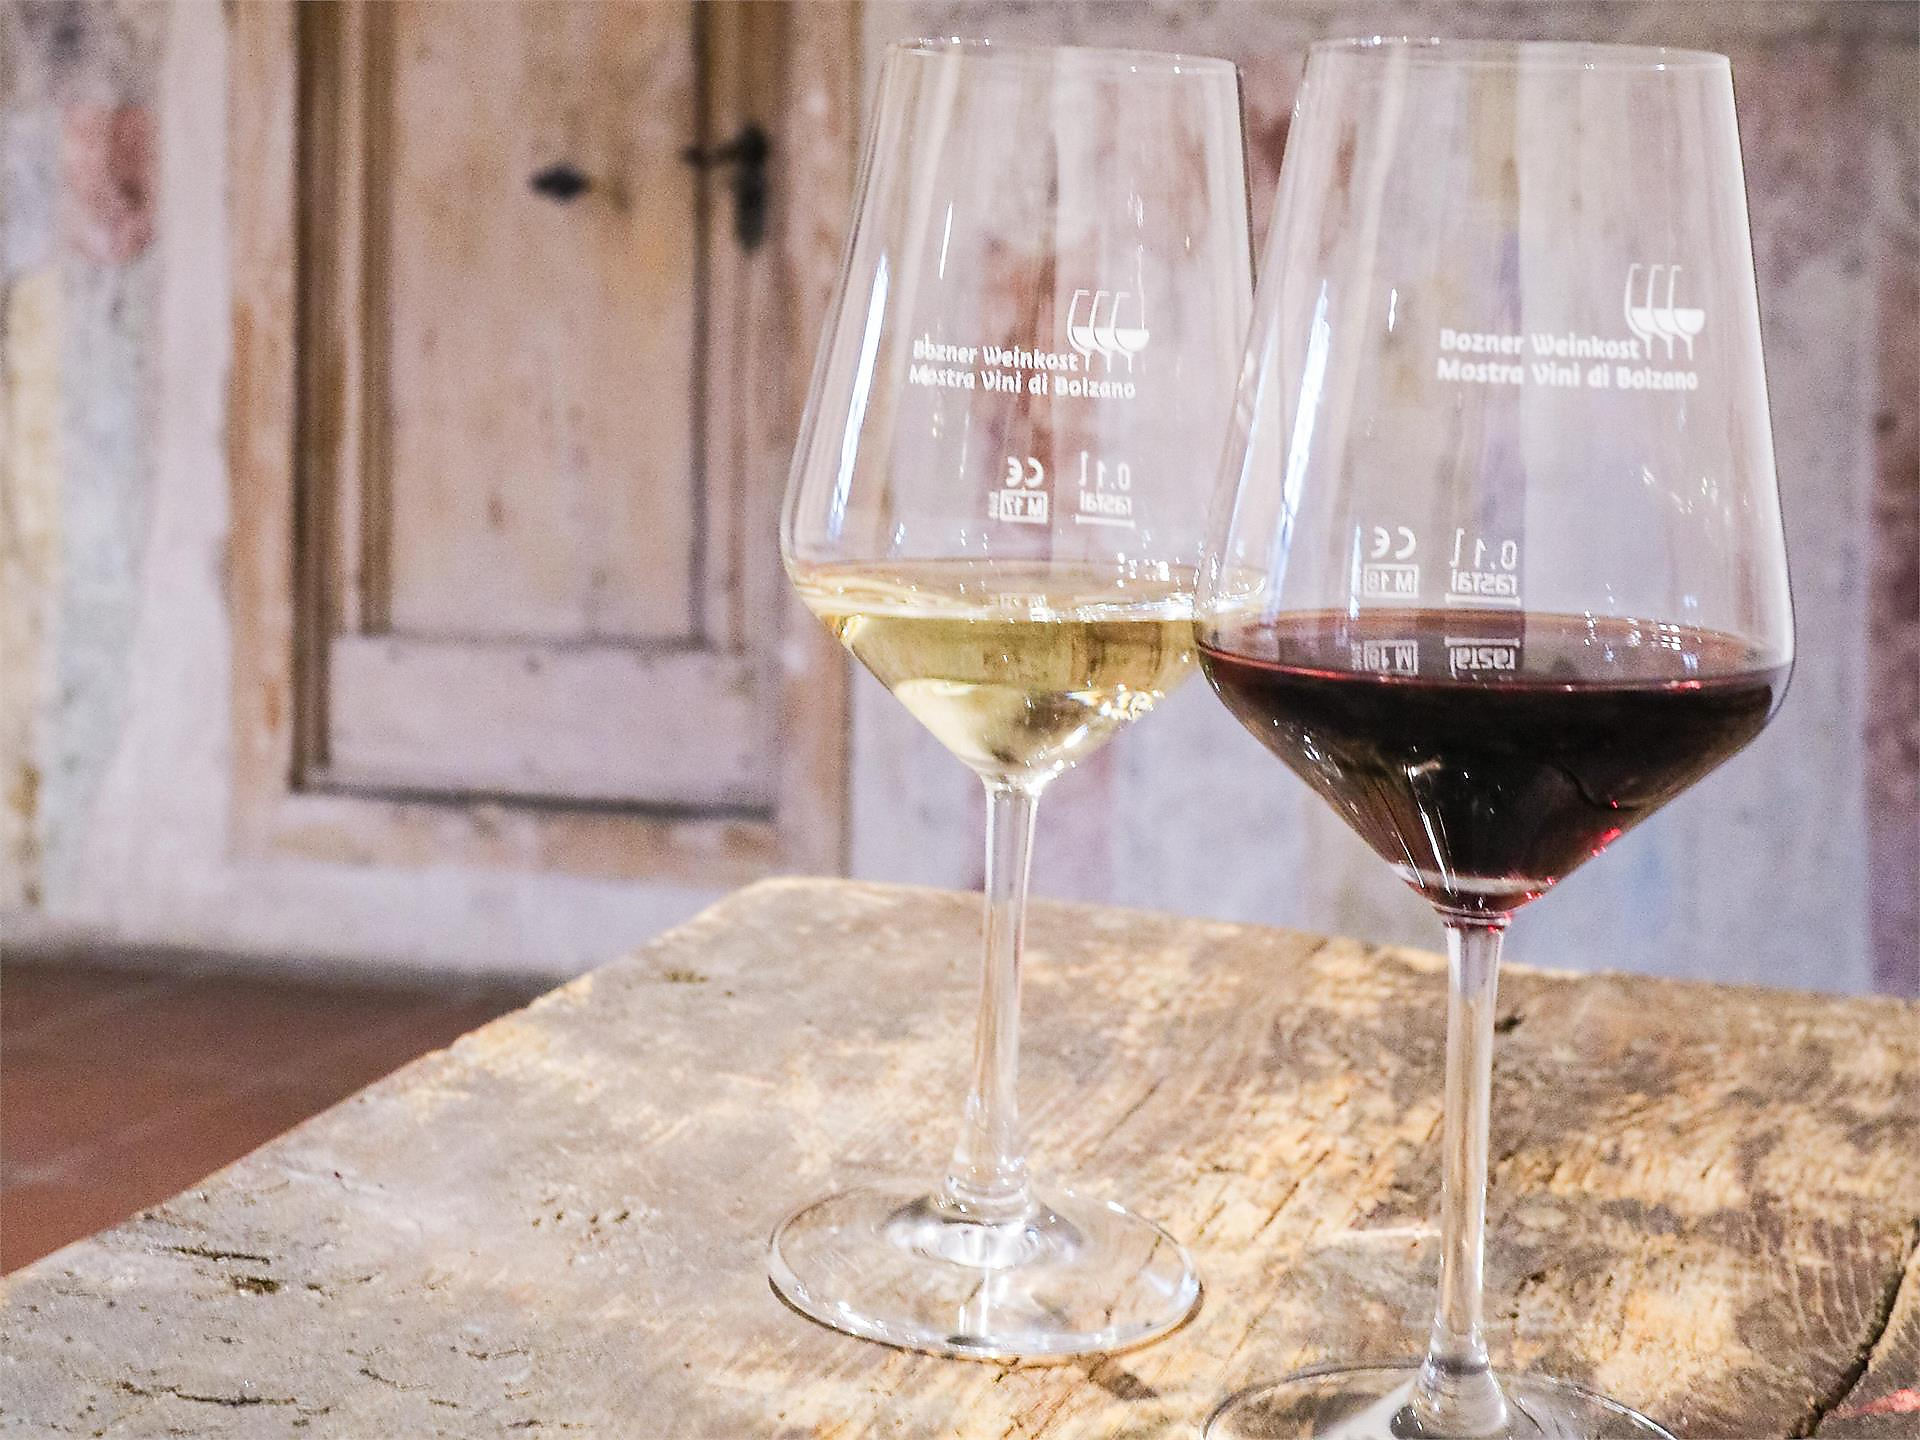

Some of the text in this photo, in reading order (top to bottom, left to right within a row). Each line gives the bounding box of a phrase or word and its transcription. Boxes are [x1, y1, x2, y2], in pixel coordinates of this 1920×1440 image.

[983, 345, 1079, 371] Weinkost
[1440, 328, 1640, 360] Bozner Weinkost
[909, 364, 1137, 400] Mostra Vini di Bolzano
[1437, 357, 1699, 391] Mostra Vini di Bolzano
